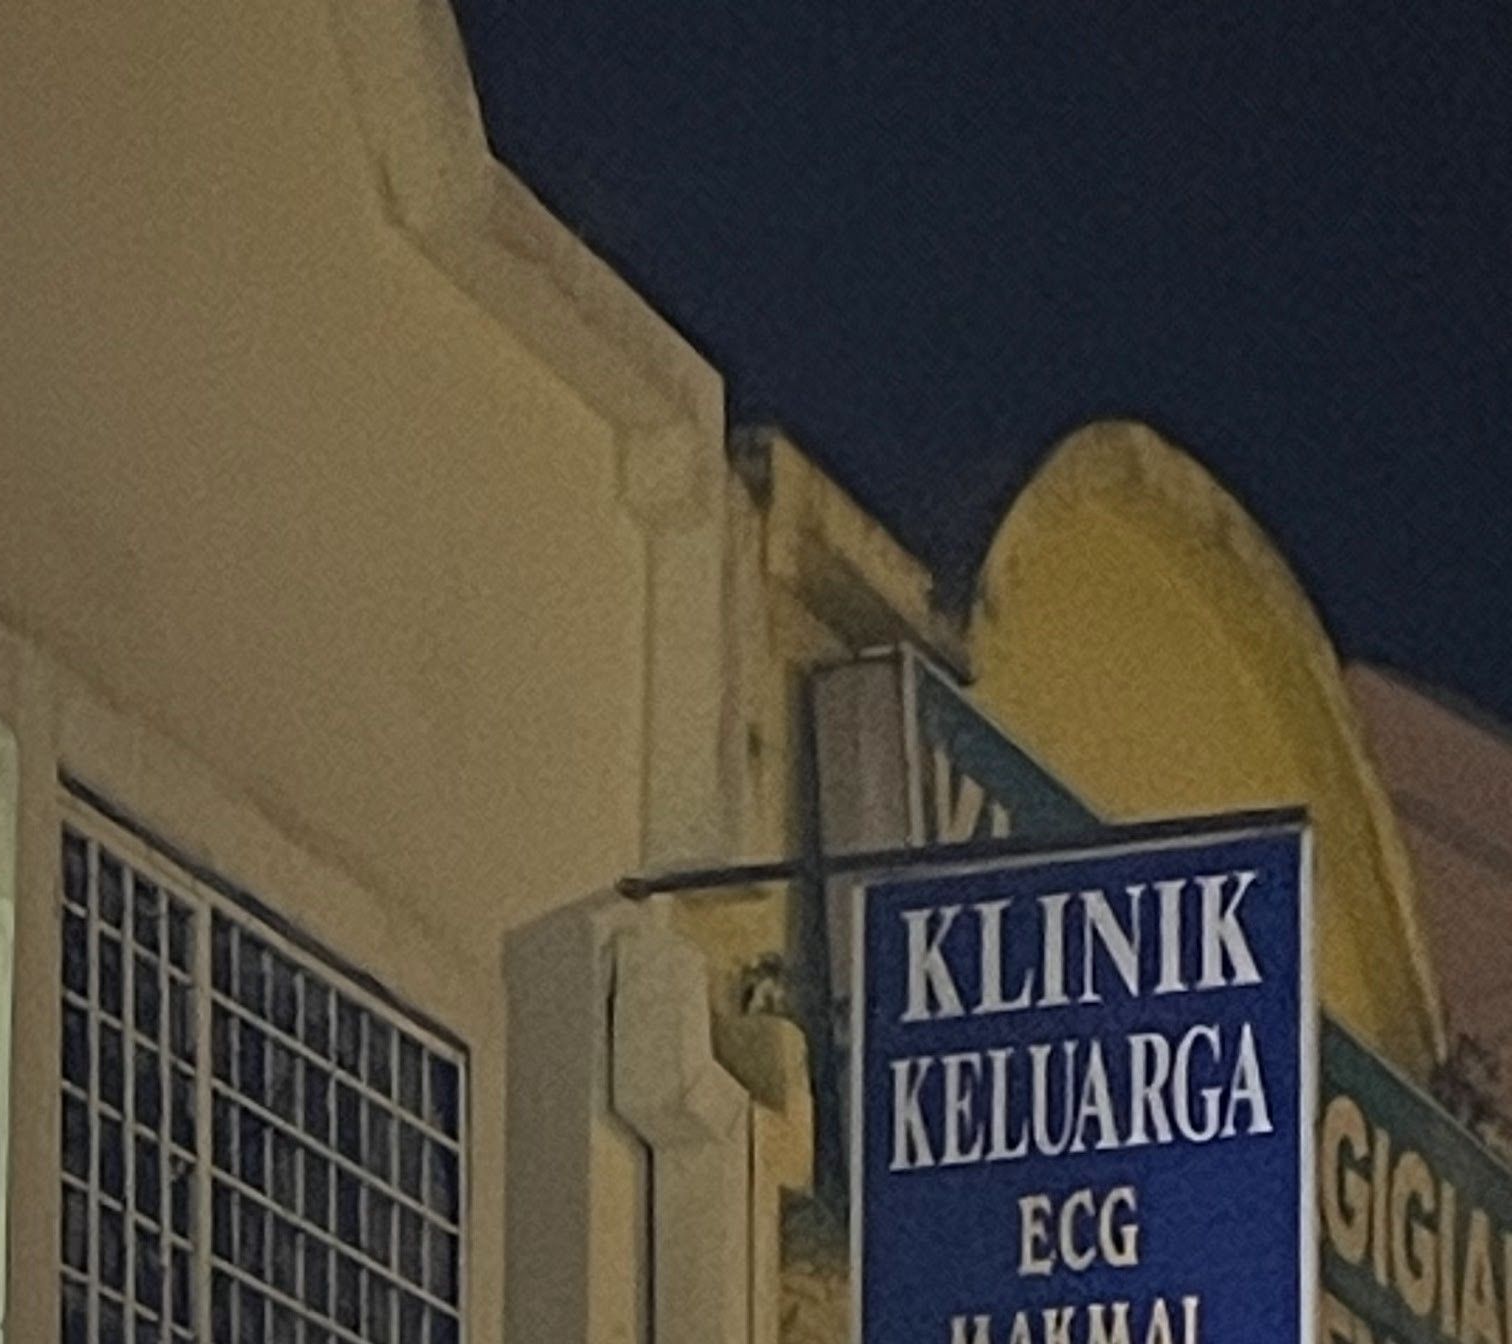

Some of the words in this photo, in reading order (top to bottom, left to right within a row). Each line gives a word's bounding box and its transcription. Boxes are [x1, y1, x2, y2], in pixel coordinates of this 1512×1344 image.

[899, 869, 1262, 1024] KLINIK
[889, 1023, 1273, 1172] KELUARGA
[1017, 1185, 1139, 1277] ECG
